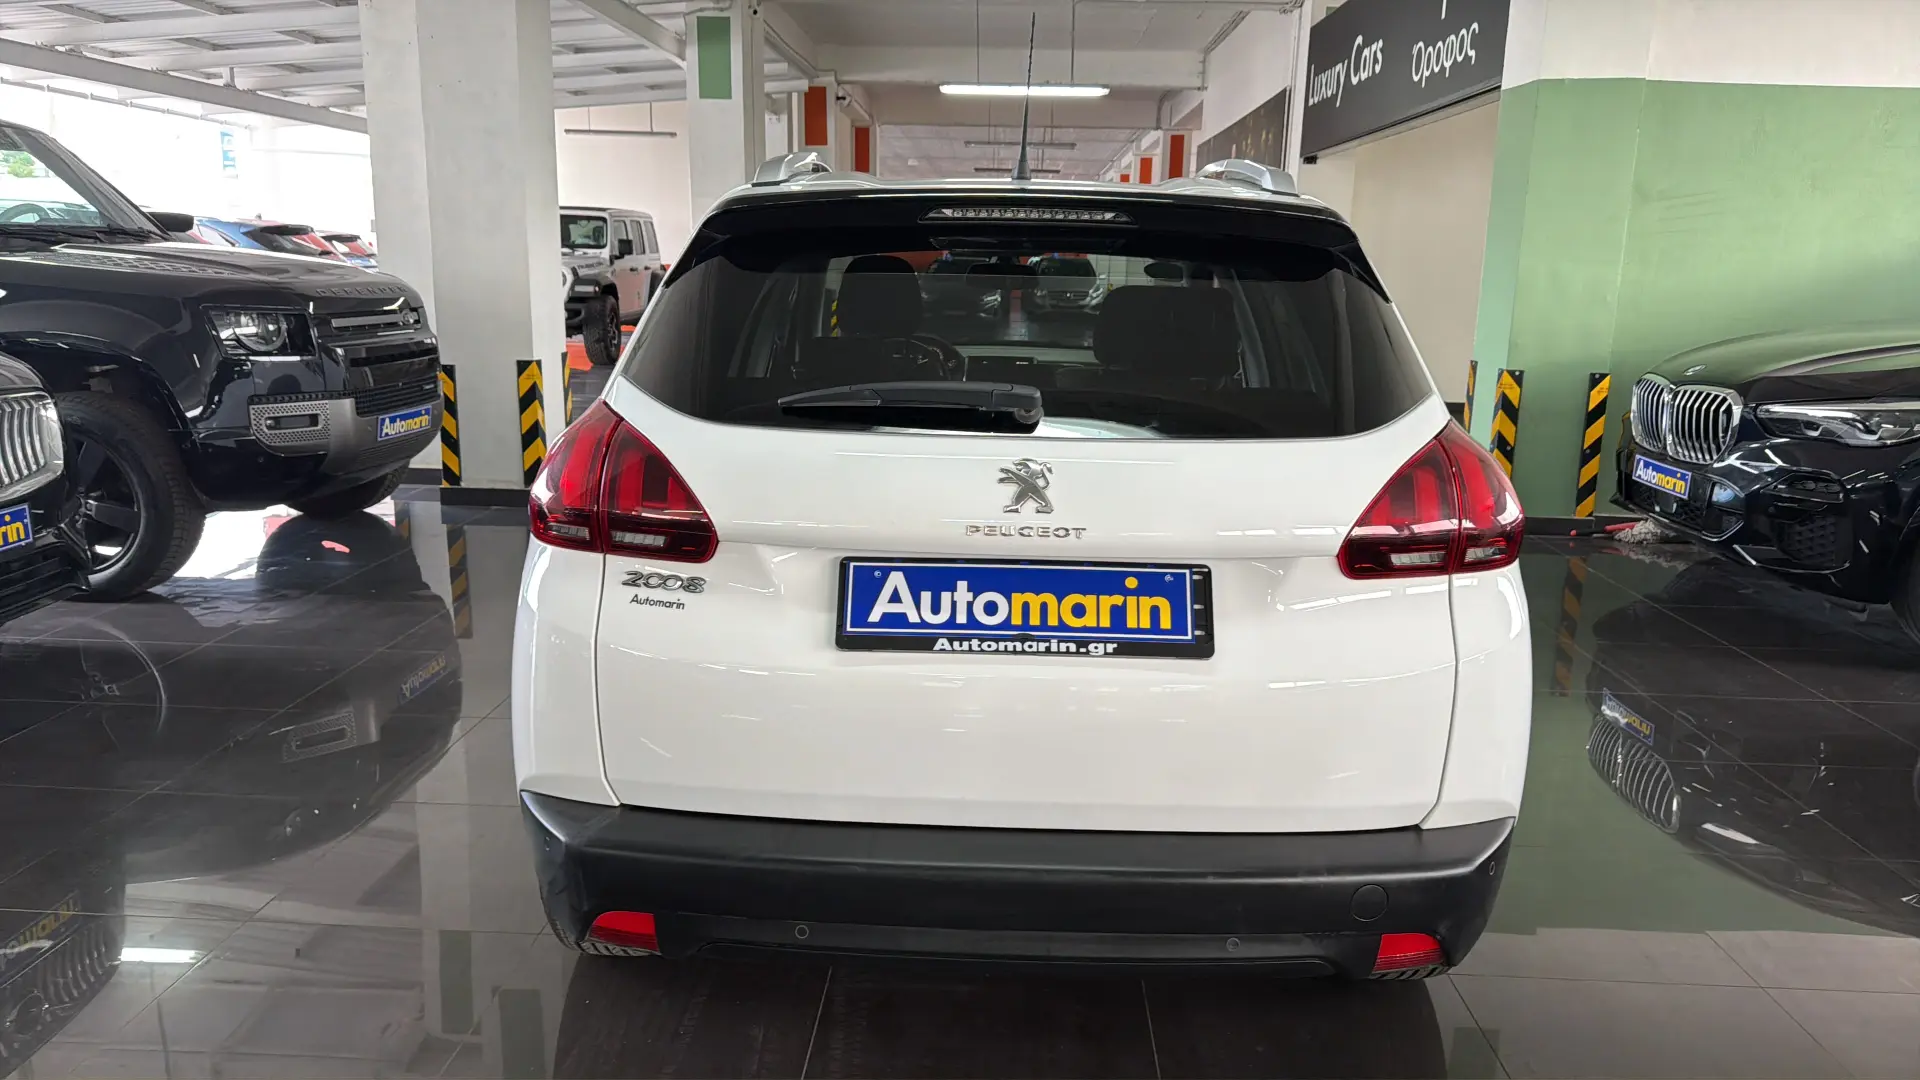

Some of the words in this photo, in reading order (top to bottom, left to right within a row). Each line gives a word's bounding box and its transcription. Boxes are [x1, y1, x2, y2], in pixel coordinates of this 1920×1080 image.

[1412, 22, 1479, 88] Όροφος
[1308, 59, 1348, 108] Luxury
[1350, 34, 1384, 85] Cars
[315, 286, 408, 297] DEFENDER
[381, 409, 429, 437] Automarin
[1635, 459, 1686, 494] Automarin
[965, 525, 1087, 540] PEUGEOT
[621, 570, 707, 594] 2008
[629, 593, 685, 610] Automarin
[867, 571, 1172, 629] Automarin
[932, 637, 1118, 656] Automarin.gr
